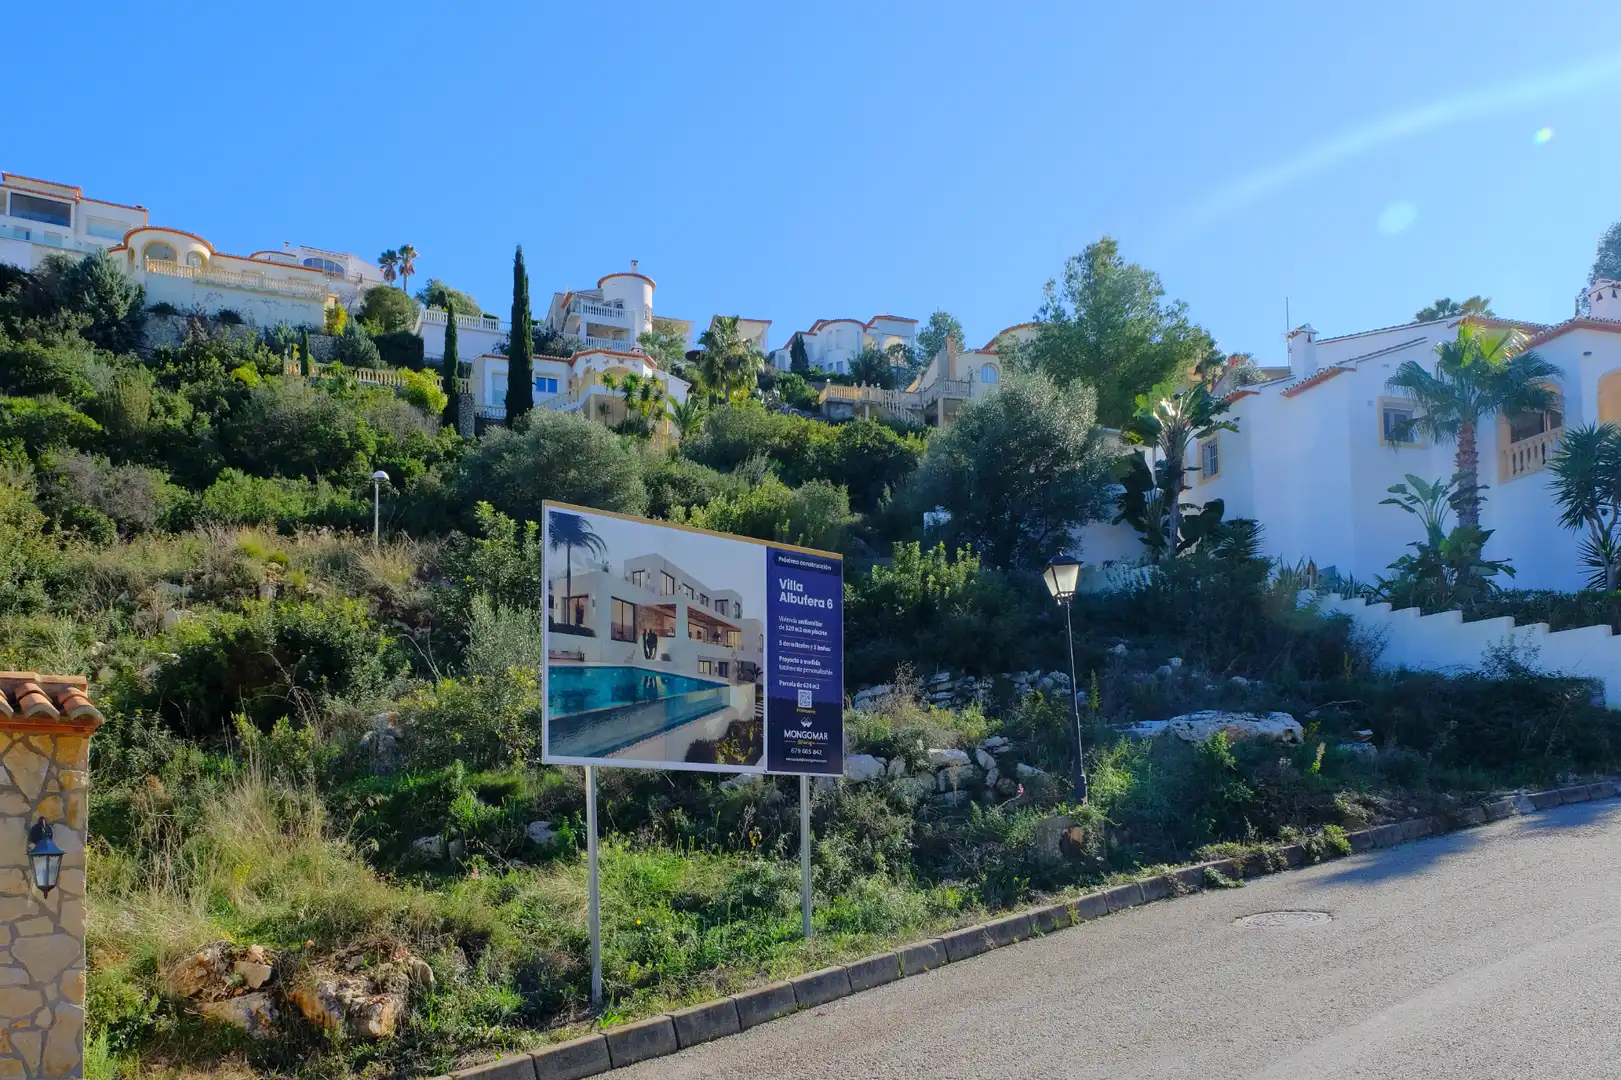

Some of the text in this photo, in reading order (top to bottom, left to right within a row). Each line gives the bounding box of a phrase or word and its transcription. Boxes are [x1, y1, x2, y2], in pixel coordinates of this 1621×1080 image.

[799, 560, 832, 571] construcción
[779, 578, 803, 592] Villa
[779, 592, 833, 609] Albufera 6
[783, 640, 810, 649] dormitorios
[778, 655, 800, 664] Proyecto
[783, 729, 829, 741] MONGOMAR
